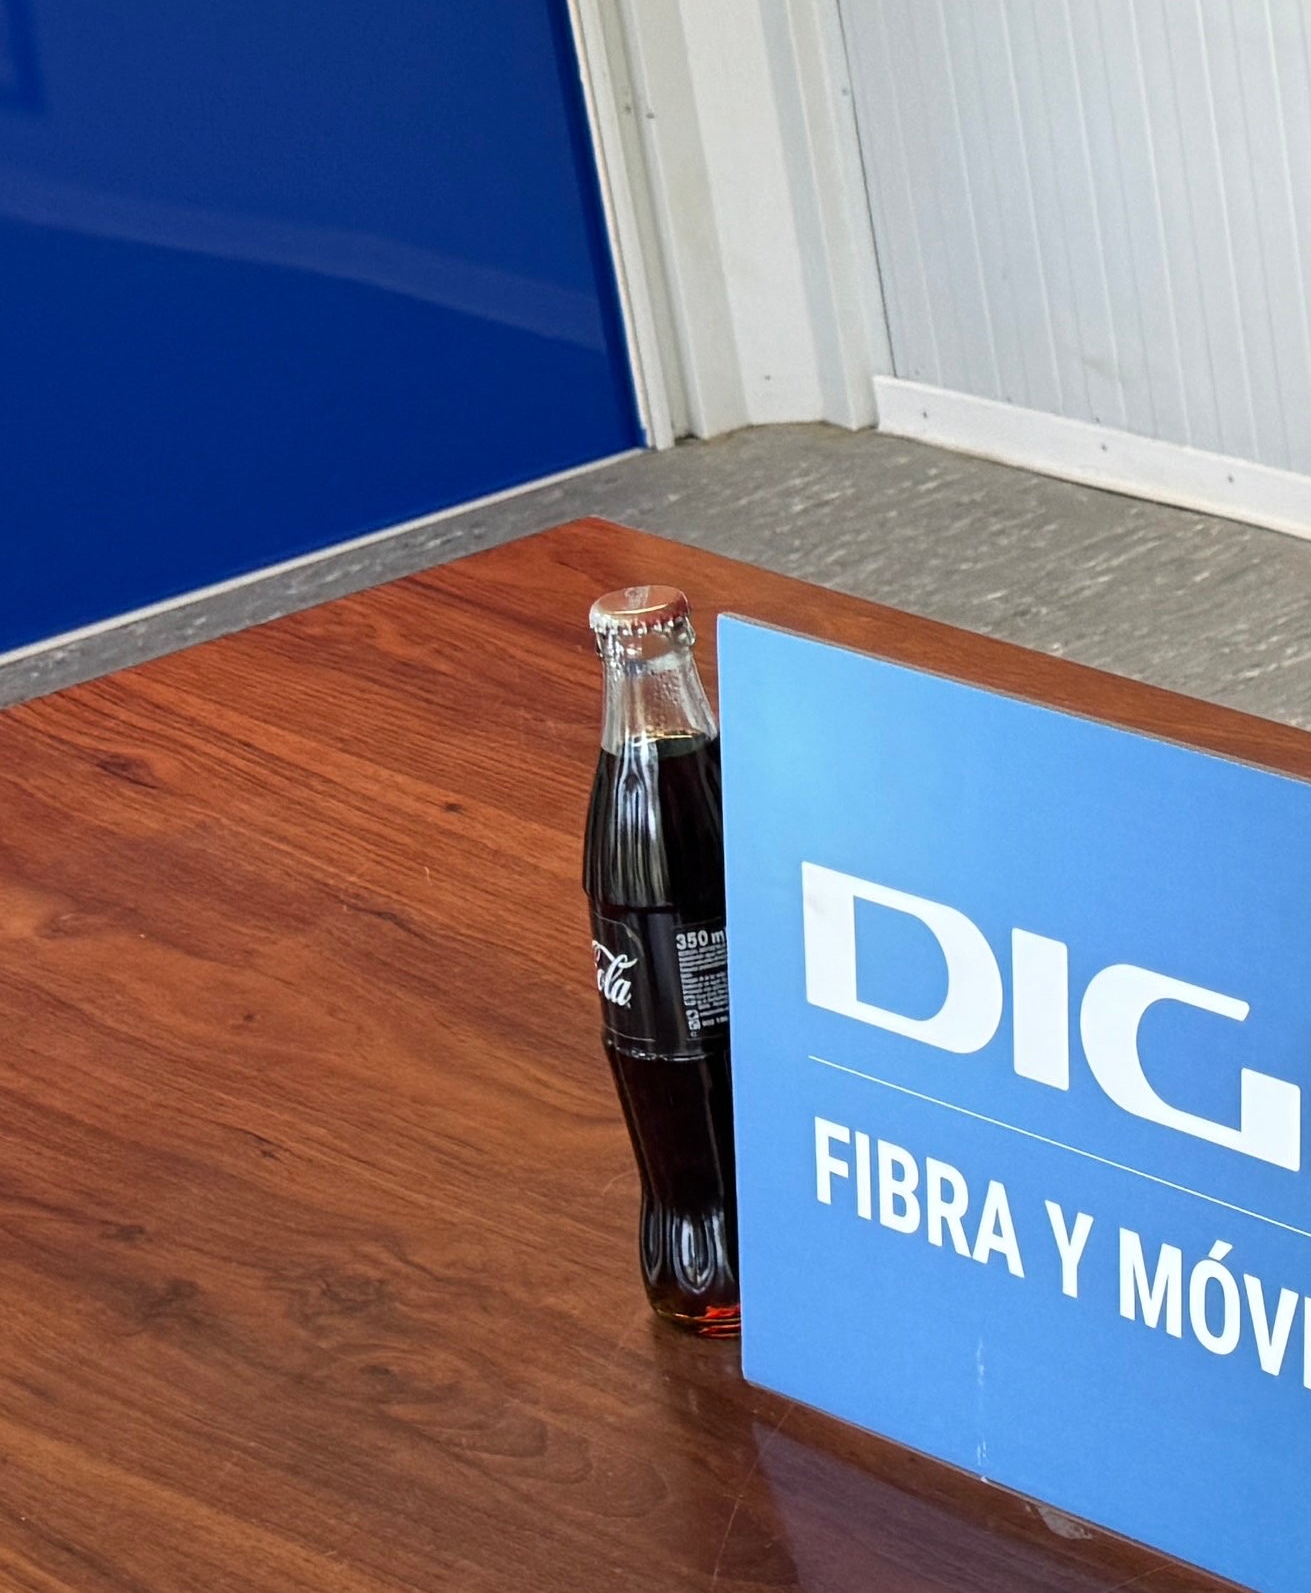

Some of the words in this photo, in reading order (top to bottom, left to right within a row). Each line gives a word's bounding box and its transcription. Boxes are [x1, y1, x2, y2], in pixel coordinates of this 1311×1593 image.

[676, 929, 708, 950] 350
[814, 1116, 1025, 1278] FIBRA
[1045, 1200, 1094, 1298] Y
